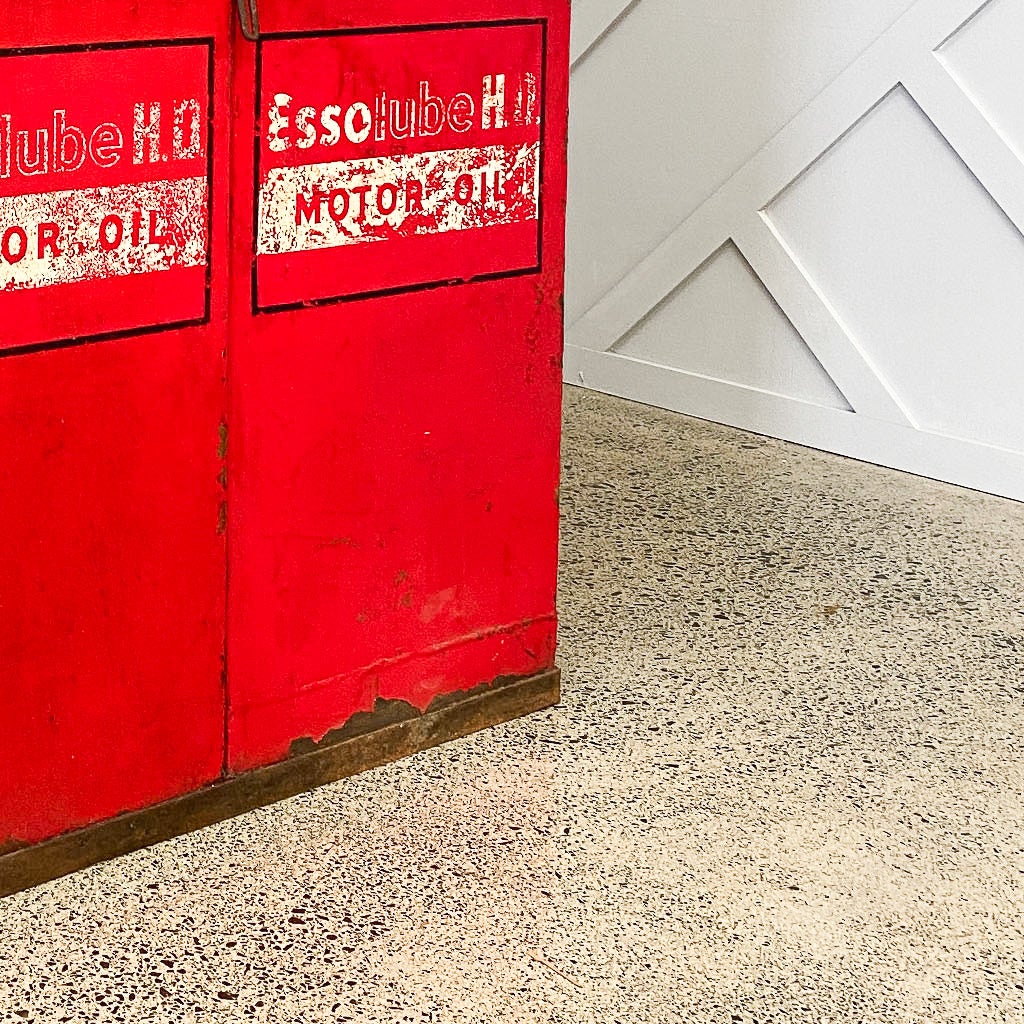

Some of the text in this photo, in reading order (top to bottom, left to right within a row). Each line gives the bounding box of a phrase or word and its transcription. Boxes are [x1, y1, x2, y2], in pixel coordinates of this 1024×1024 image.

[267, 80, 474, 153] Essolube
[294, 170, 506, 225] MOTOR OIL
[99, 209, 173, 253] OIL
